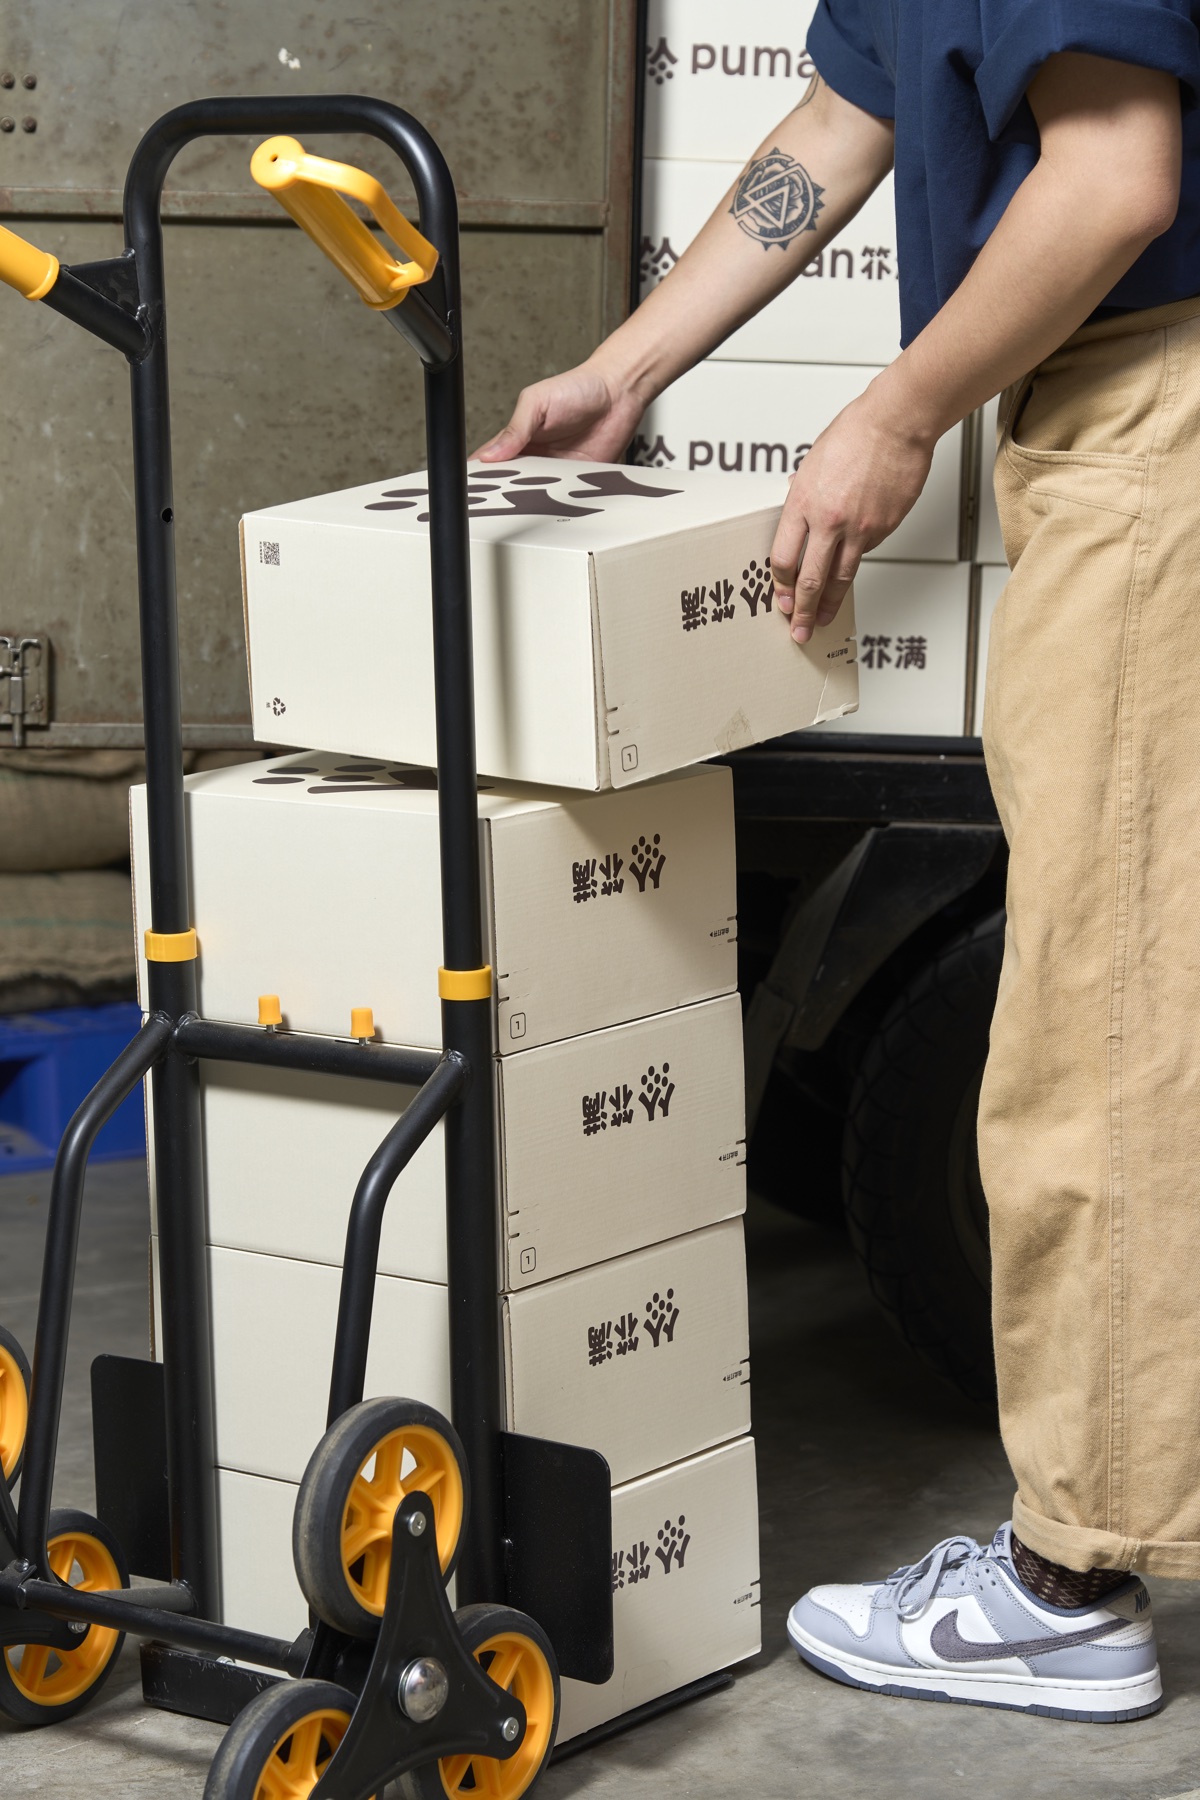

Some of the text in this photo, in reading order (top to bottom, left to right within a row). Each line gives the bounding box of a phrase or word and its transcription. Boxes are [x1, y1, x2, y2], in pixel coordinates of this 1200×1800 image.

[626, 752, 632, 762] 1
[515, 1020, 520, 1030] 1
[525, 1255, 531, 1265] 1
[995, 1529, 1006, 1547] NIKE
